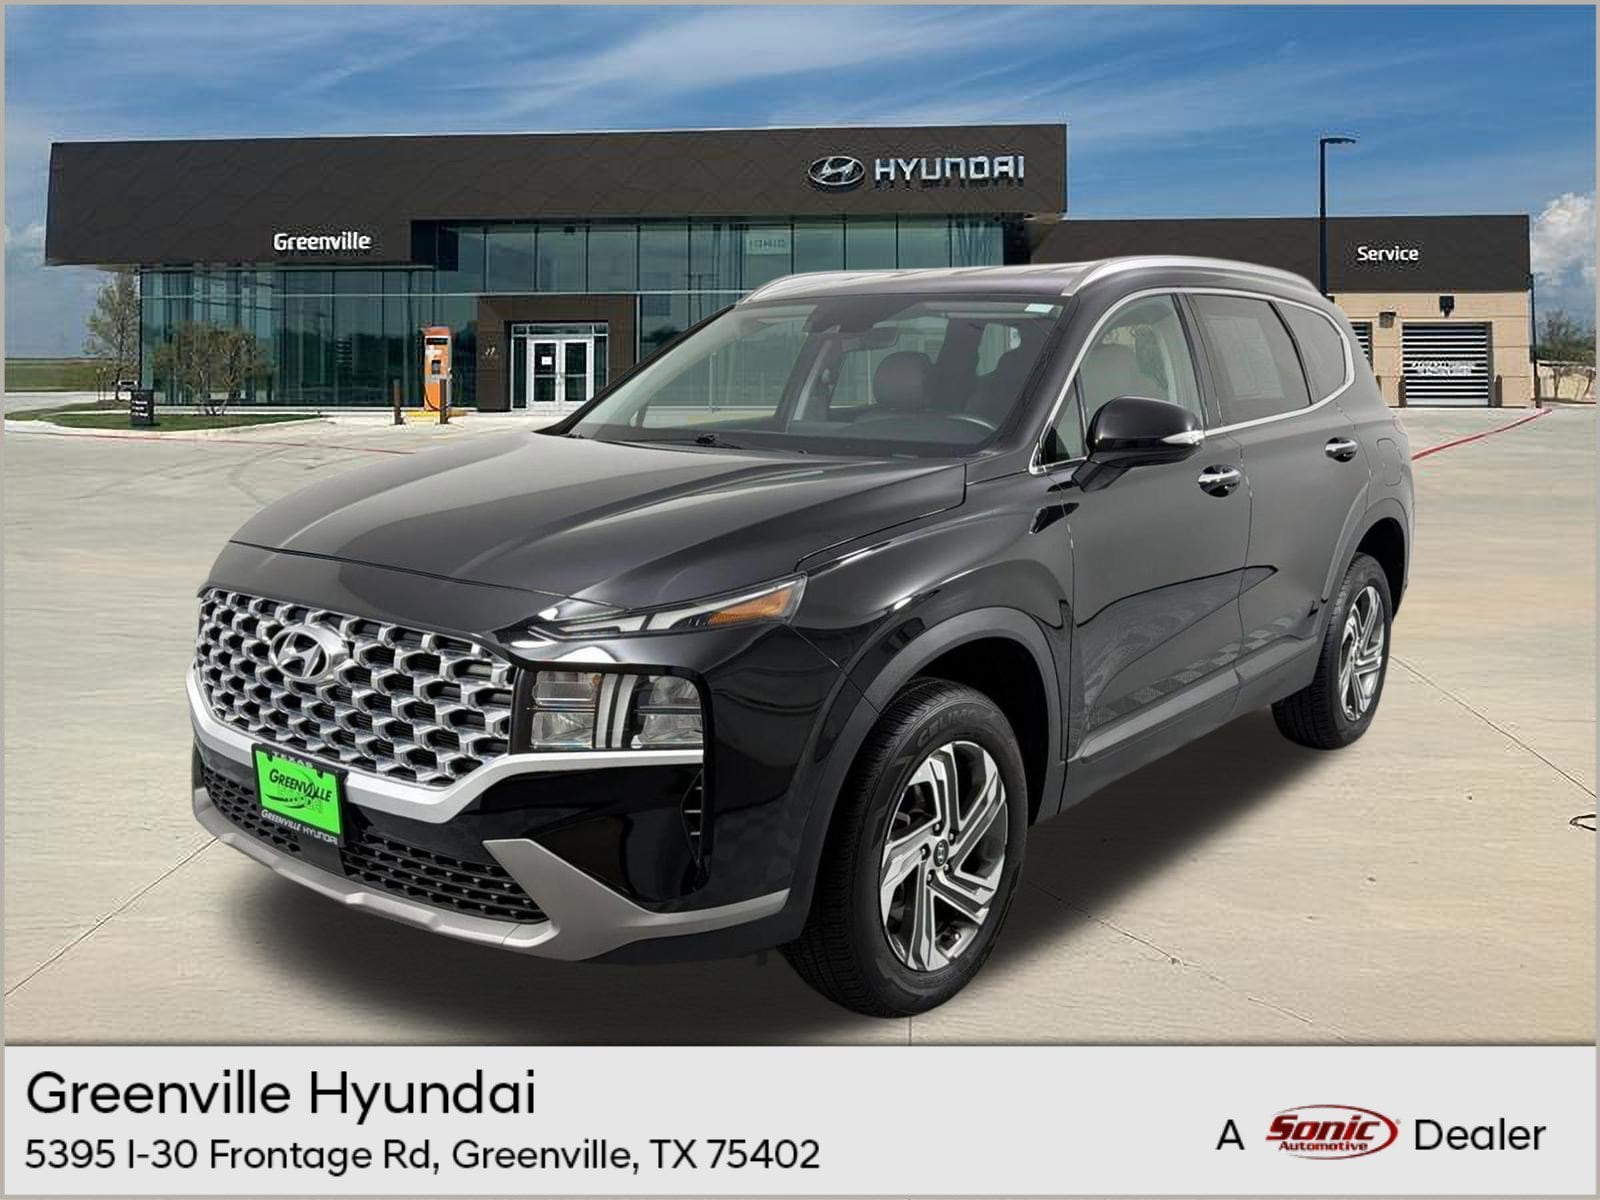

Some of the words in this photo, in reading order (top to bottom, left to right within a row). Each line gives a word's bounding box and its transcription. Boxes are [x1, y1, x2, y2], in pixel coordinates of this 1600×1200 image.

[874, 155, 1025, 181] HYUNDAI
[273, 231, 372, 251] Greenville
[1356, 245, 1419, 262] Service
[260, 808, 301, 831] GREENVILLE
[302, 826, 338, 844] HYUNDAI
